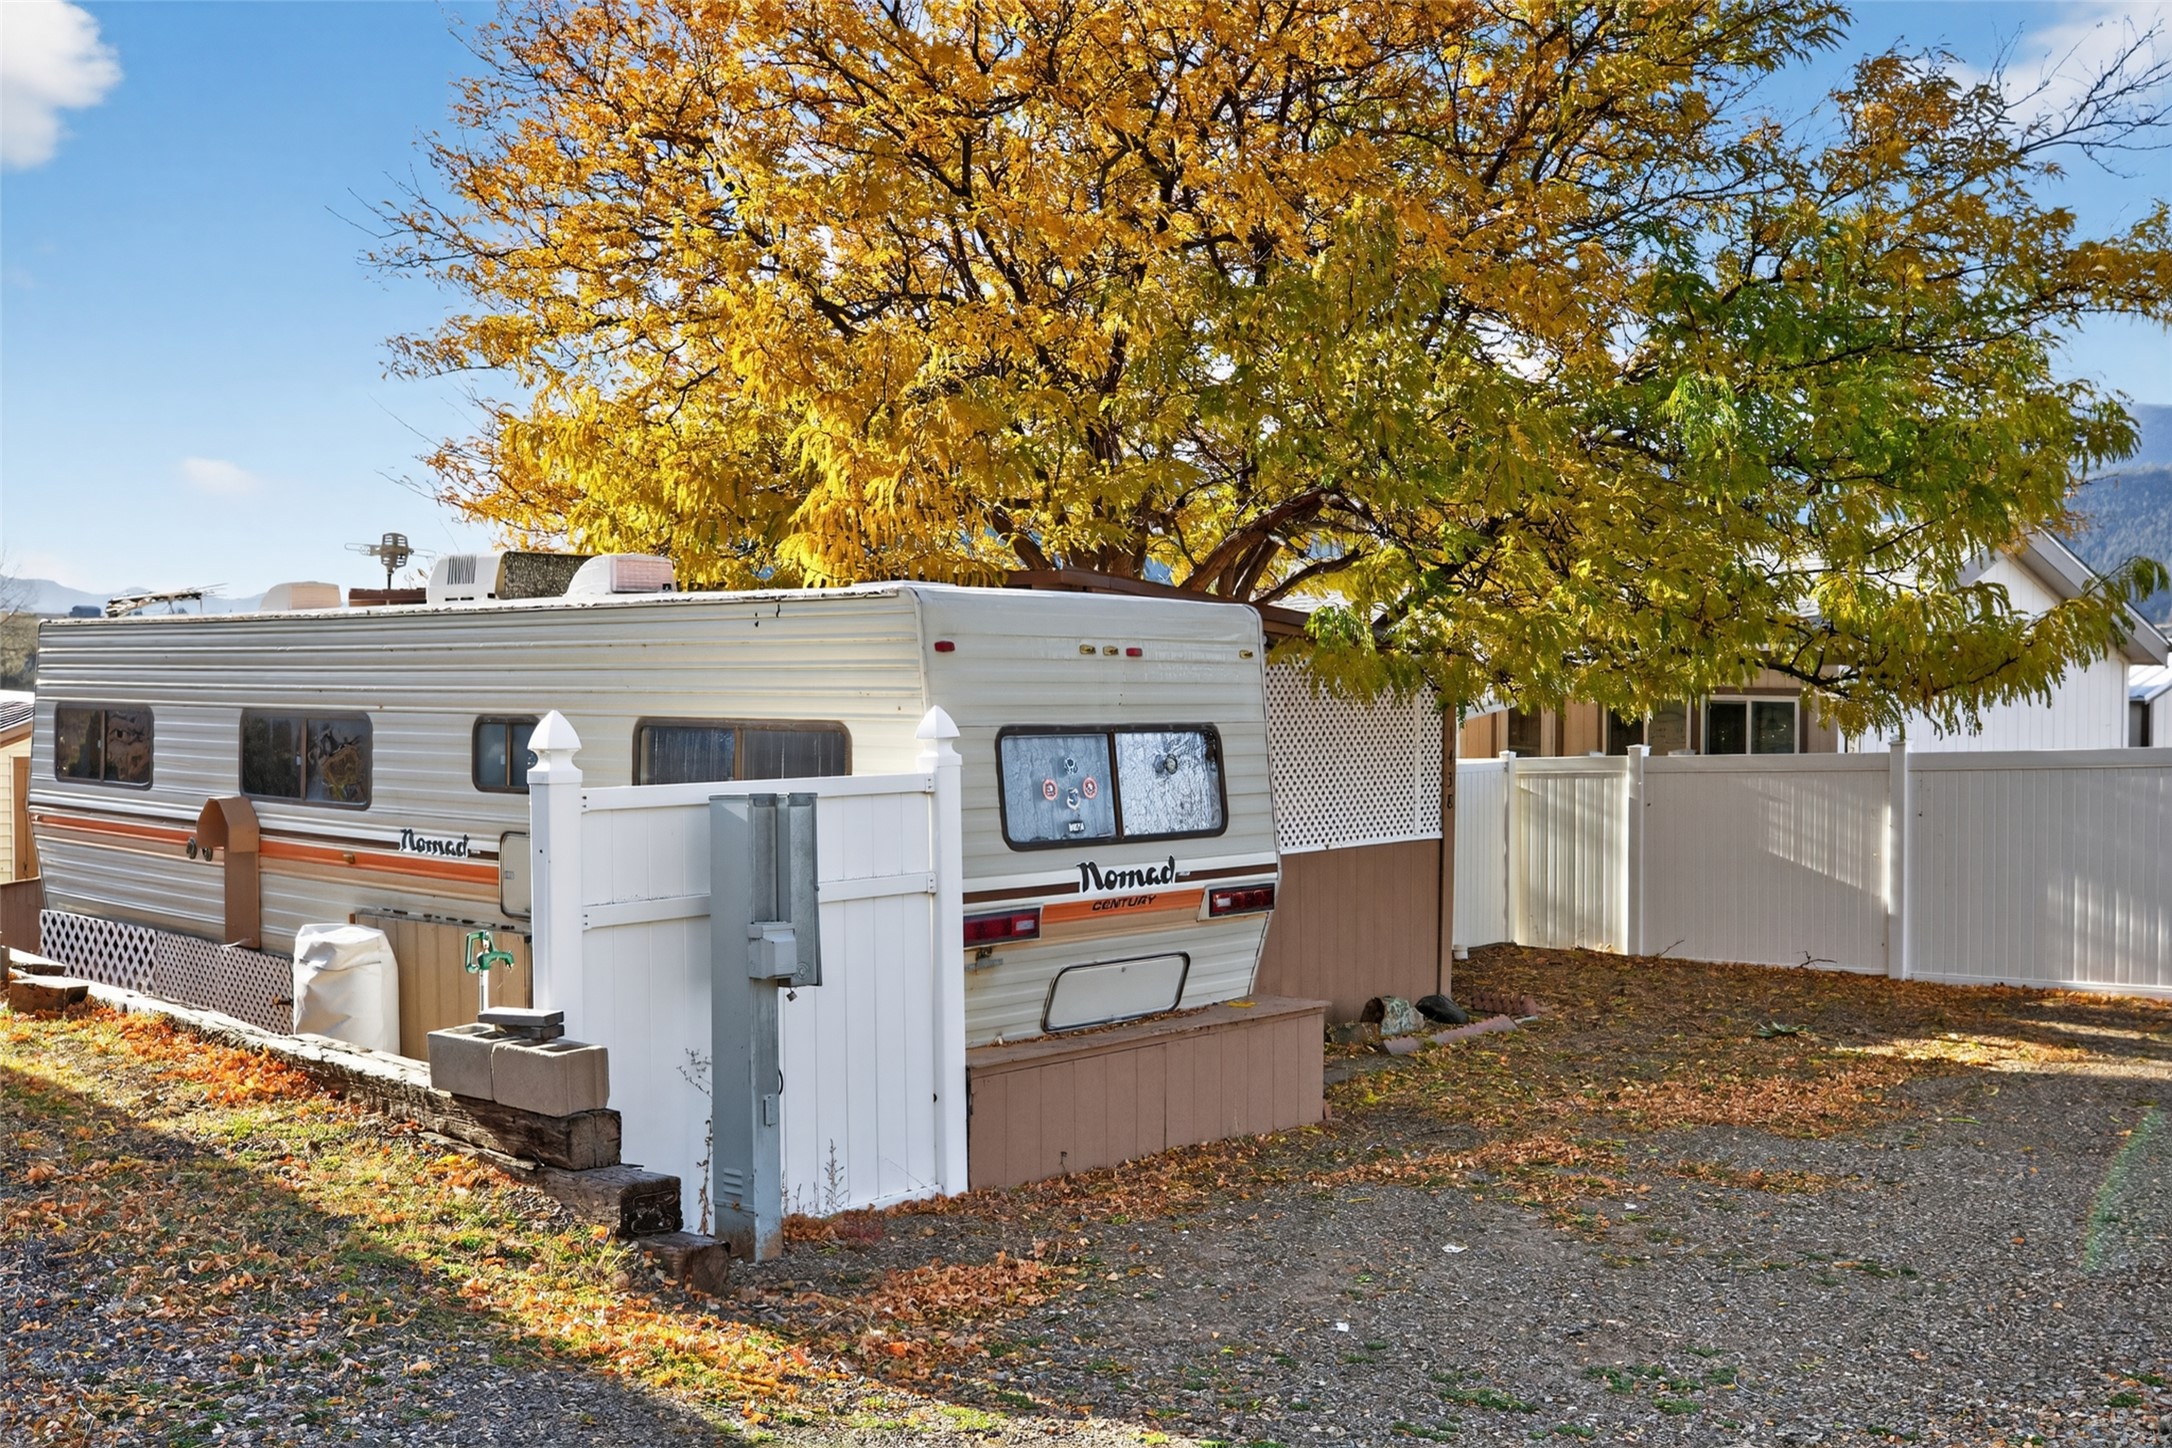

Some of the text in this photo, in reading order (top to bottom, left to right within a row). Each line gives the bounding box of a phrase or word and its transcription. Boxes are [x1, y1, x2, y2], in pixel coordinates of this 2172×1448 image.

[401, 828, 469, 856] Nomad
[1077, 855, 1175, 892] Nomad
[1092, 894, 1156, 910] CENTURY
